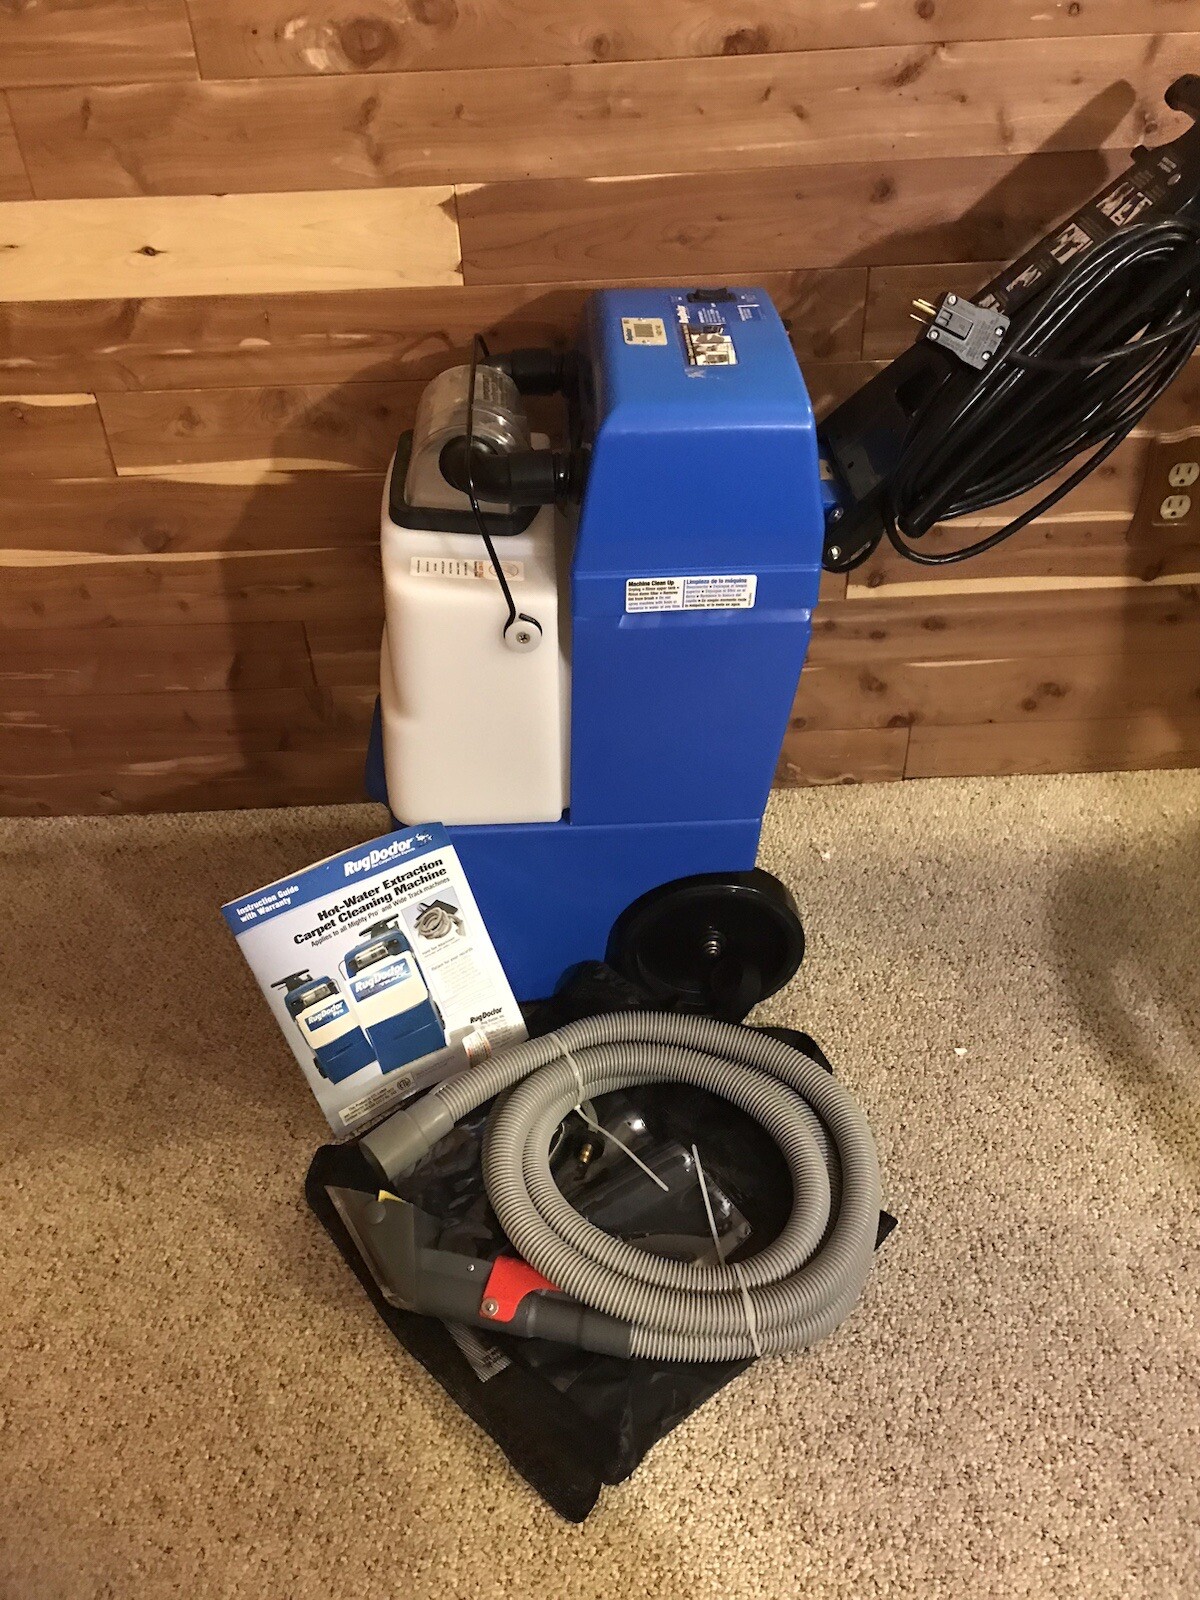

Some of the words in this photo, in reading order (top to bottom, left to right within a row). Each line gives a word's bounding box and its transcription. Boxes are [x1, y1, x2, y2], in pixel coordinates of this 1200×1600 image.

[343, 837, 414, 877] RugDoctor
[236, 894, 278, 916] Instruction
[277, 885, 299, 899] Guide
[240, 911, 257, 922] with
[257, 897, 291, 915] Warranty
[294, 919, 337, 944] Carpet
[338, 893, 393, 923] Cleaning
[394, 868, 447, 896] Machine
[317, 886, 380, 921] Hot-Water
[382, 859, 443, 890] Extraction
[311, 933, 332, 947] Applies
[347, 916, 368, 928] Mighty
[381, 904, 393, 912] and
[392, 897, 407, 907] Wide
[408, 889, 423, 899] Track
[423, 877, 450, 892] machines
[470, 1007, 502, 1024] RugDoctor
